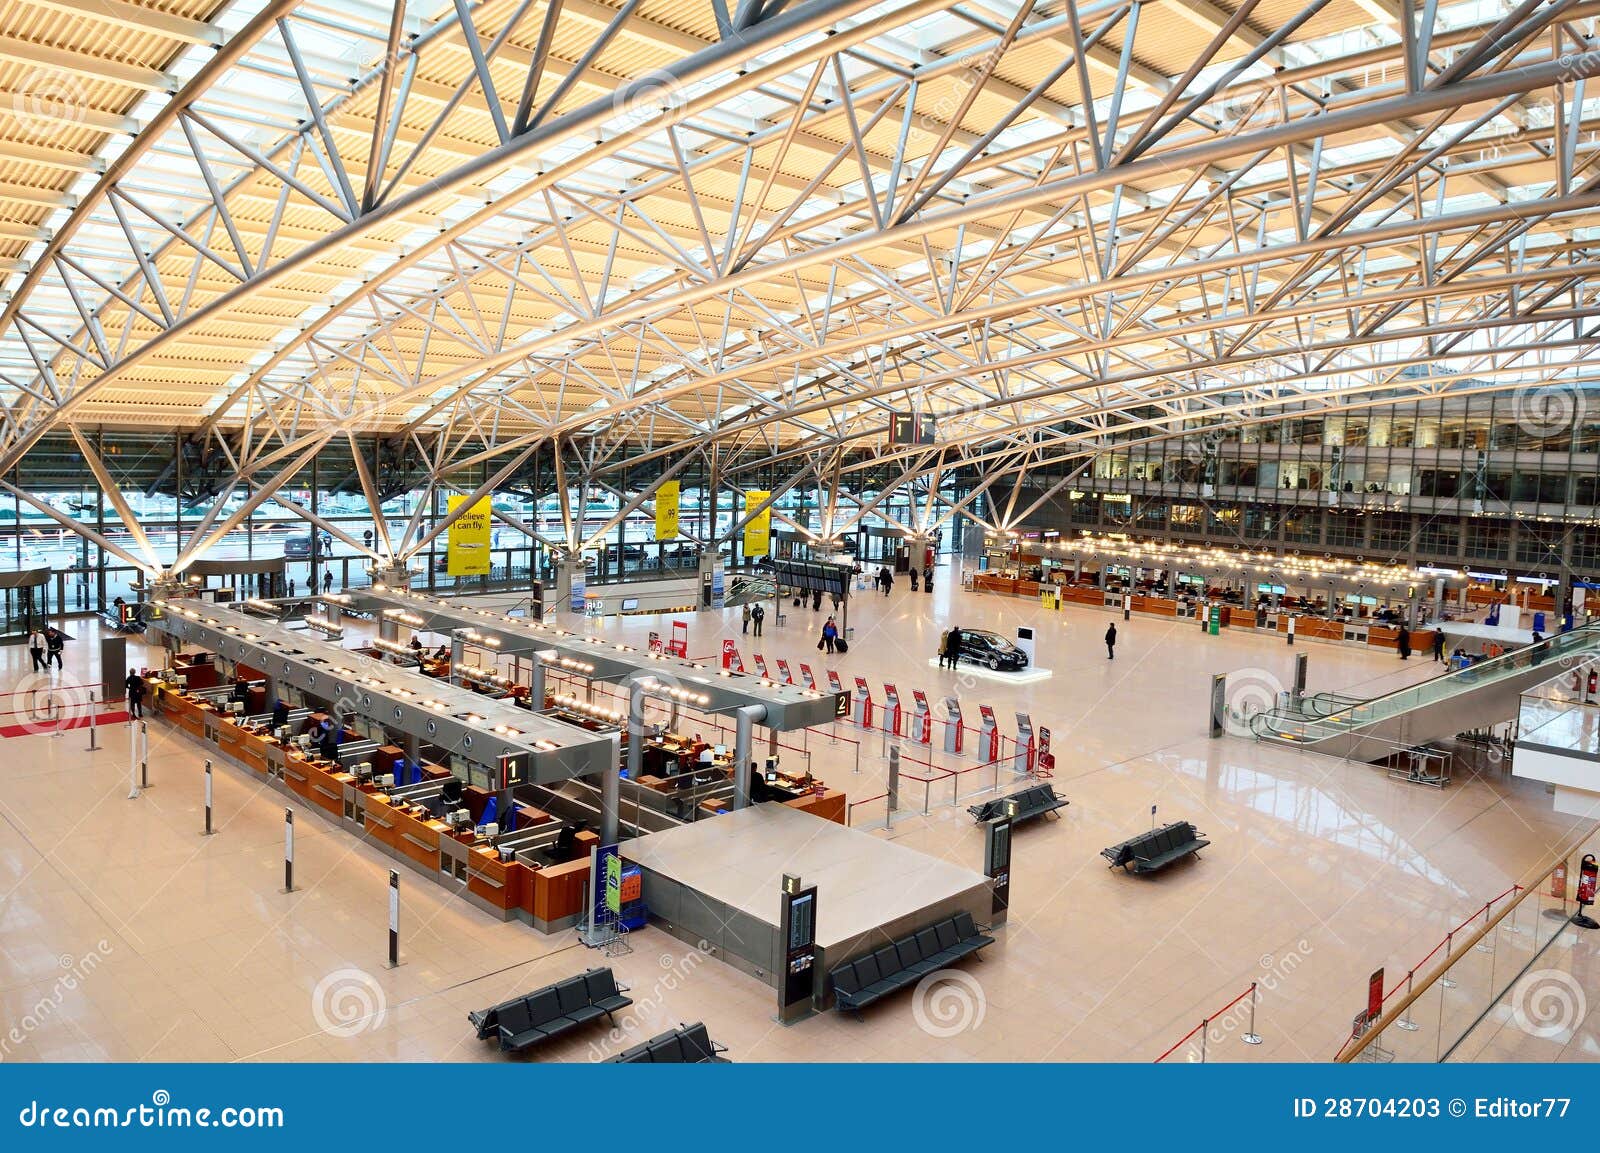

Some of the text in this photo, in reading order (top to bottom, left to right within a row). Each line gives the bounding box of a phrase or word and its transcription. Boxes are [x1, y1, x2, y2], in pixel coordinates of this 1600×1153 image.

[896, 423, 902, 437] 1
[473, 521, 484, 531] fly.
[126, 606, 133, 618] 1
[839, 695, 846, 710] 2
[509, 760, 516, 778] 1
